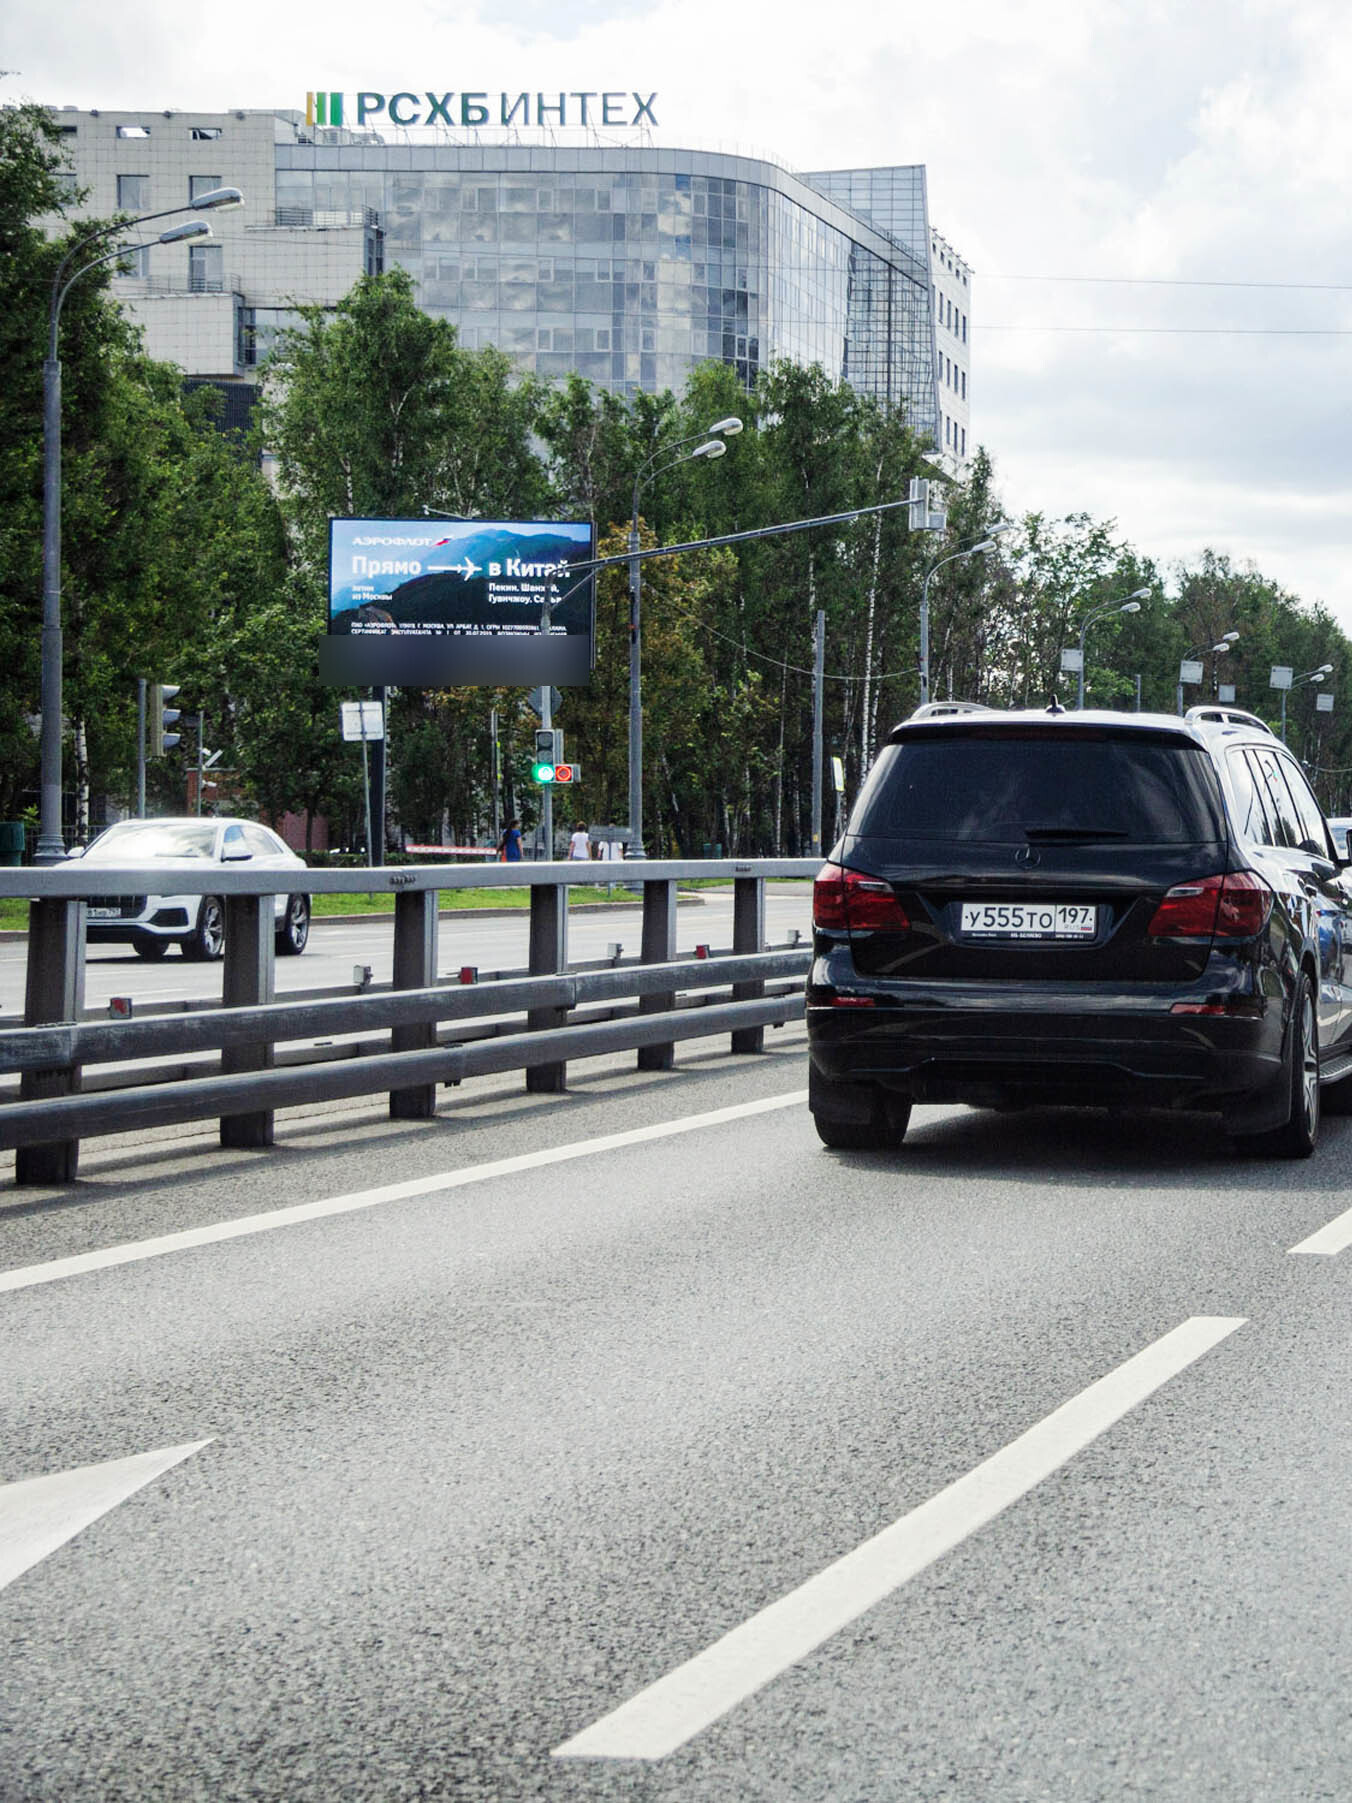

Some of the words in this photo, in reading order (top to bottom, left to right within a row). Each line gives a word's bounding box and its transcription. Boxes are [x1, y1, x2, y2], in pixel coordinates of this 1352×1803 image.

[357, 92, 489, 126] РСХБ
[500, 92, 659, 126] ИНТЕХ
[351, 536, 432, 546] АЭРОФЛОТ
[351, 556, 422, 579] Прямо
[488, 562, 502, 577] в
[506, 558, 571, 578] Китай
[521, 583, 560, 593] Шанхй,
[533, 594, 562, 604] Саья
[970, 907, 1053, 929] У555ТО
[1058, 907, 1089, 924] 197
